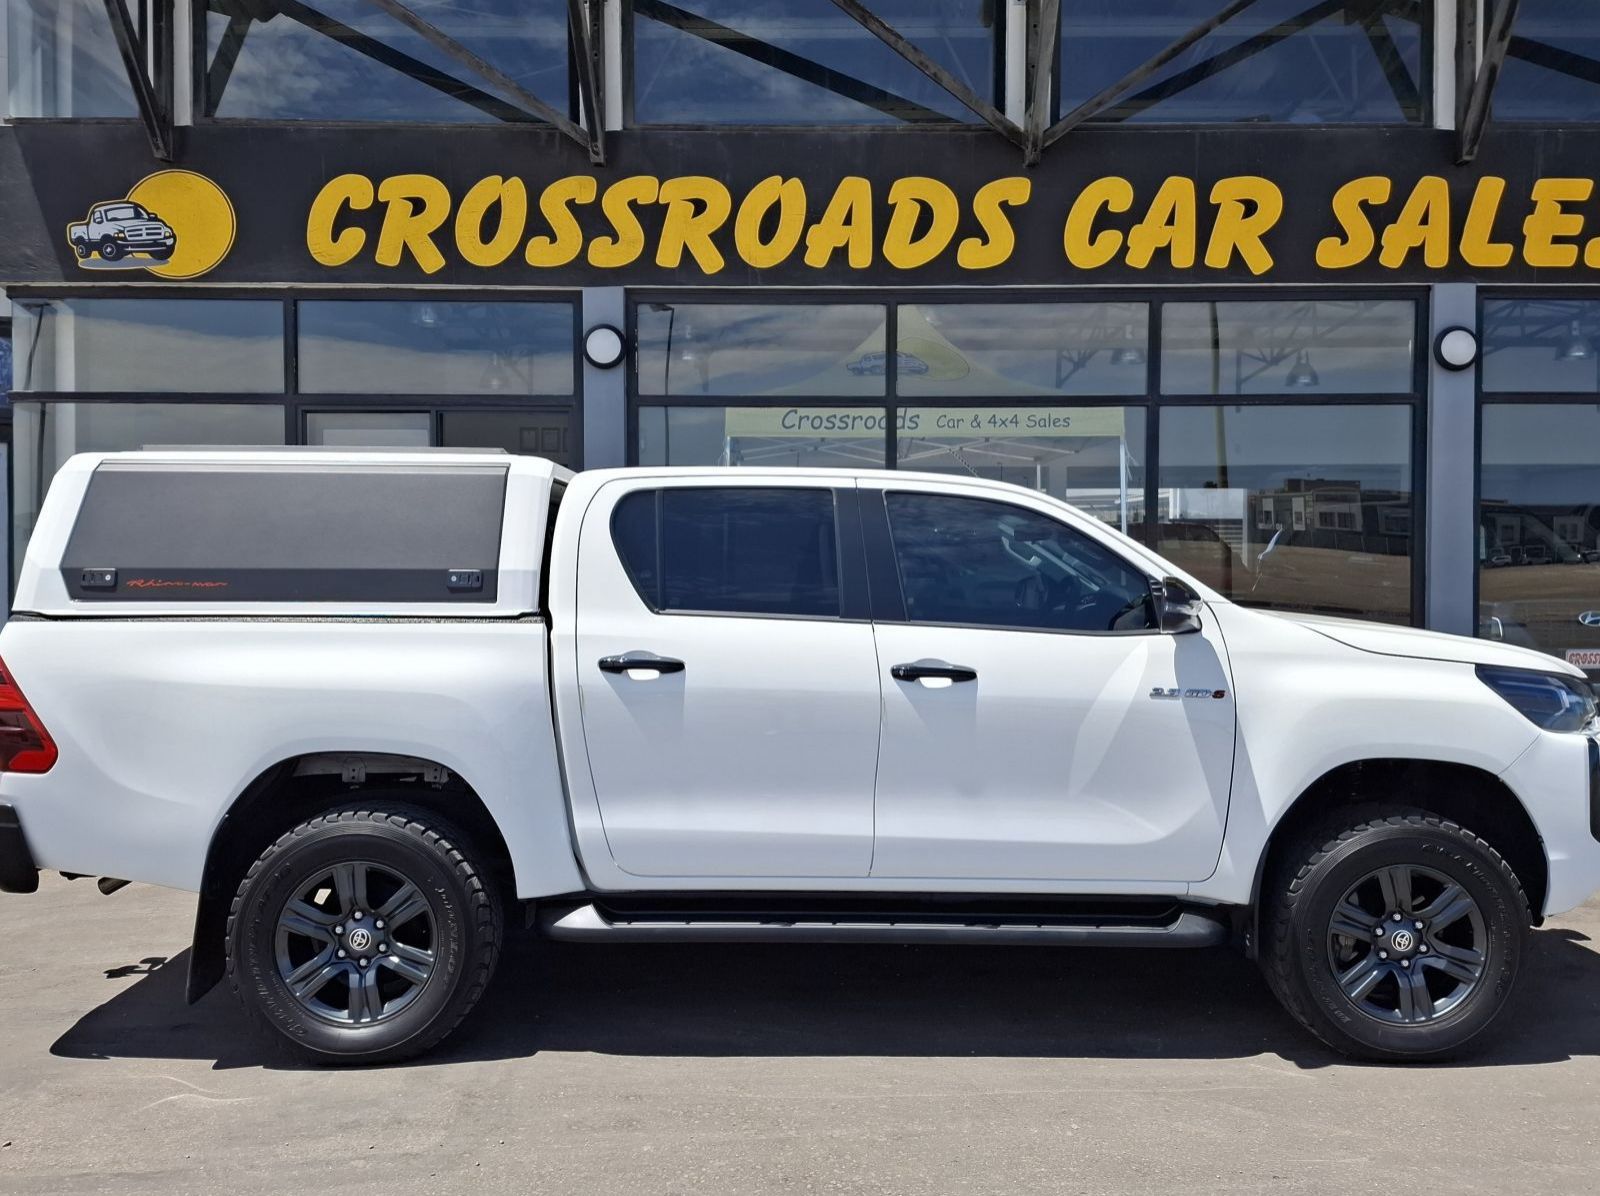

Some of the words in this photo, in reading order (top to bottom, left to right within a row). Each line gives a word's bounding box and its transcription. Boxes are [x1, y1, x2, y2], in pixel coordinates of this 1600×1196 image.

[307, 175, 1031, 275] CROSSROADS
[1065, 176, 1283, 275] CAR
[1315, 176, 1600, 269] SALE
[782, 407, 920, 430] Crossroads
[936, 414, 965, 429] Car
[971, 414, 982, 428] &
[987, 414, 1019, 428] 4x4
[1026, 413, 1071, 429] Sales
[1569, 652, 1600, 665] CROSS
